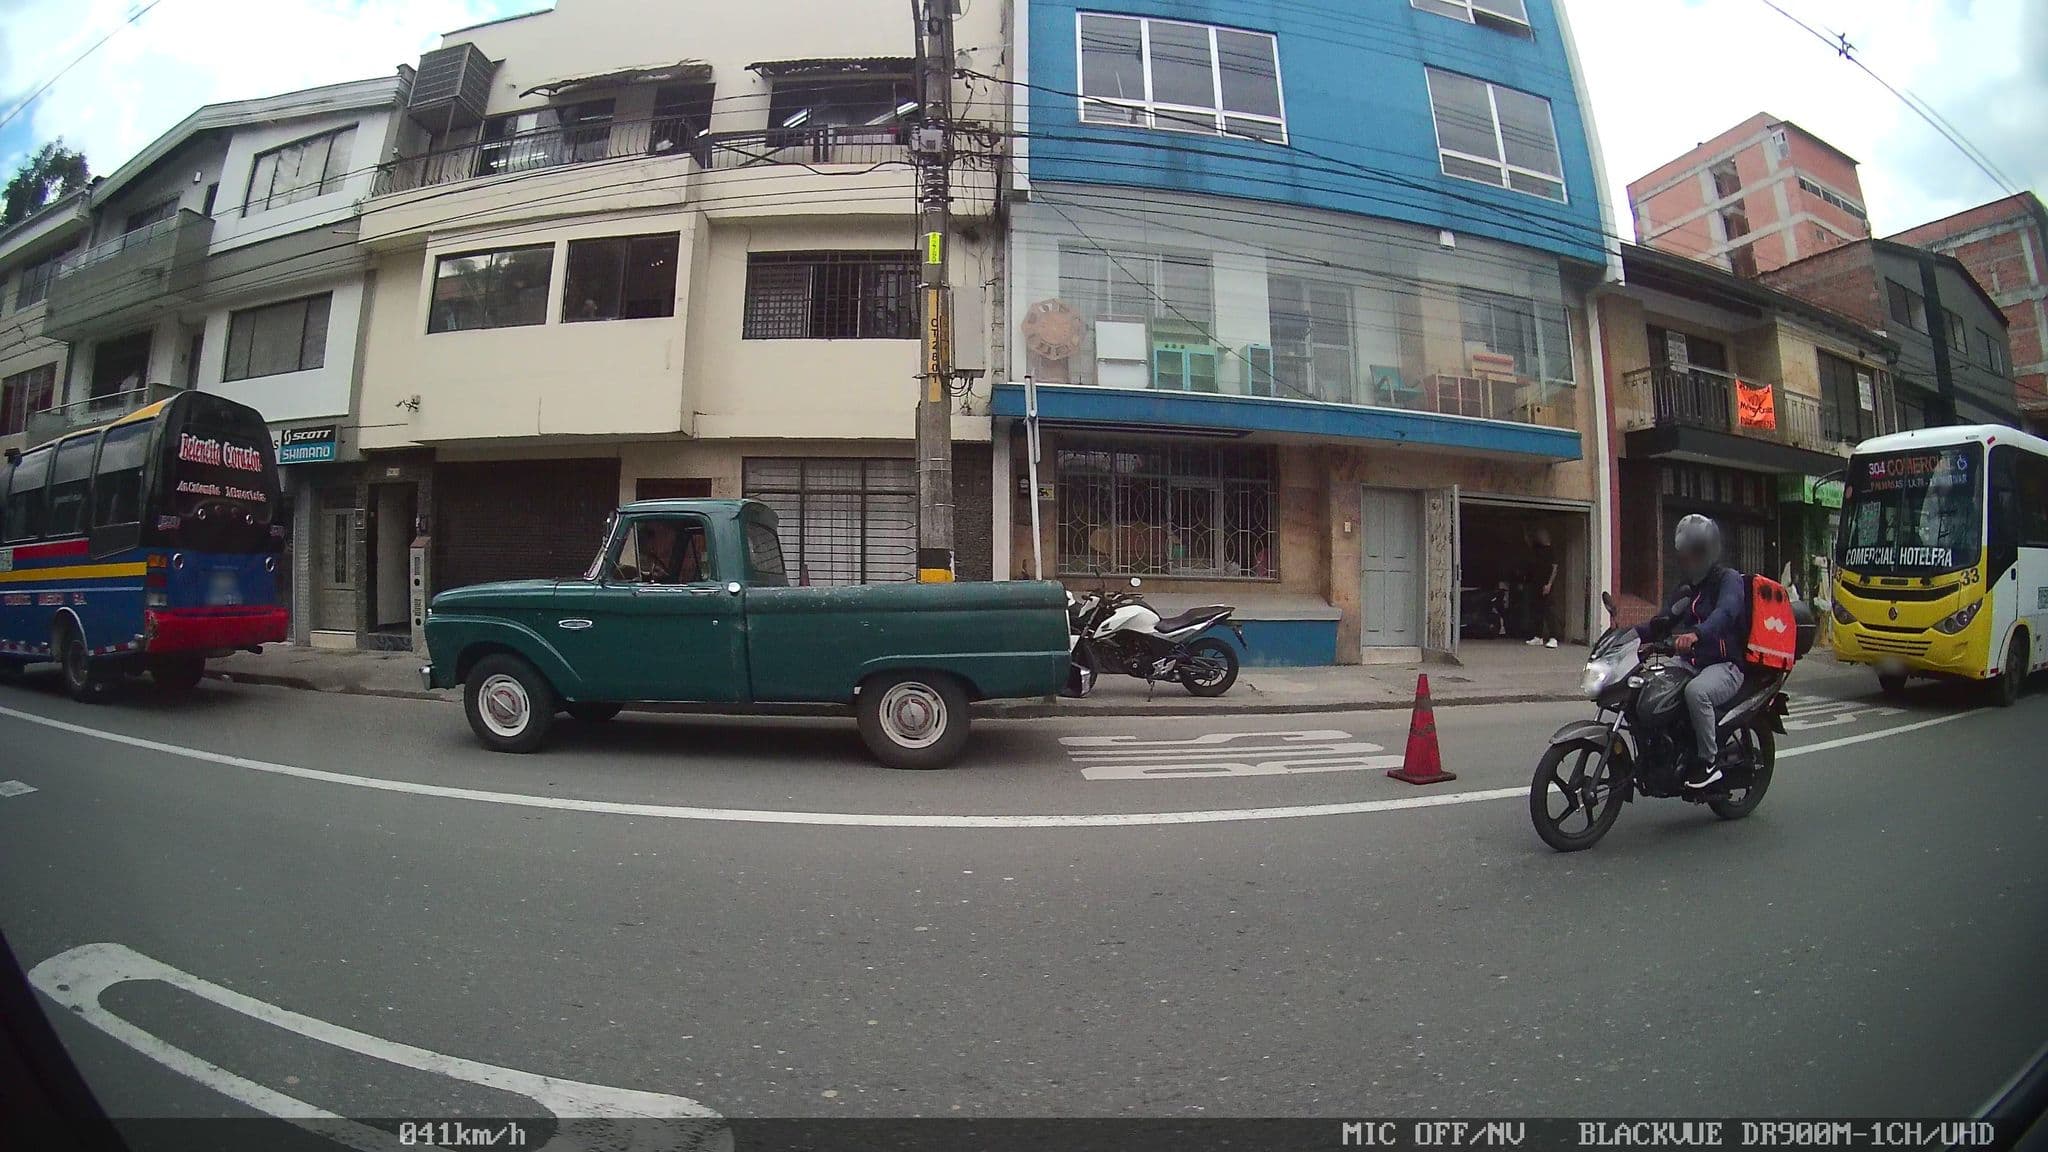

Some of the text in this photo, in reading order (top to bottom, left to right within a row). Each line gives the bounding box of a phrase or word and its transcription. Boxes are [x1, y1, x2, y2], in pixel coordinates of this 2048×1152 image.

[292, 429, 331, 440] SCOTT
[282, 446, 330, 460] SHIMANO
[1868, 461, 1885, 475] 304
[1845, 546, 1952, 567] COMERCIAL HOTELERA
[1960, 567, 1980, 585] 33
